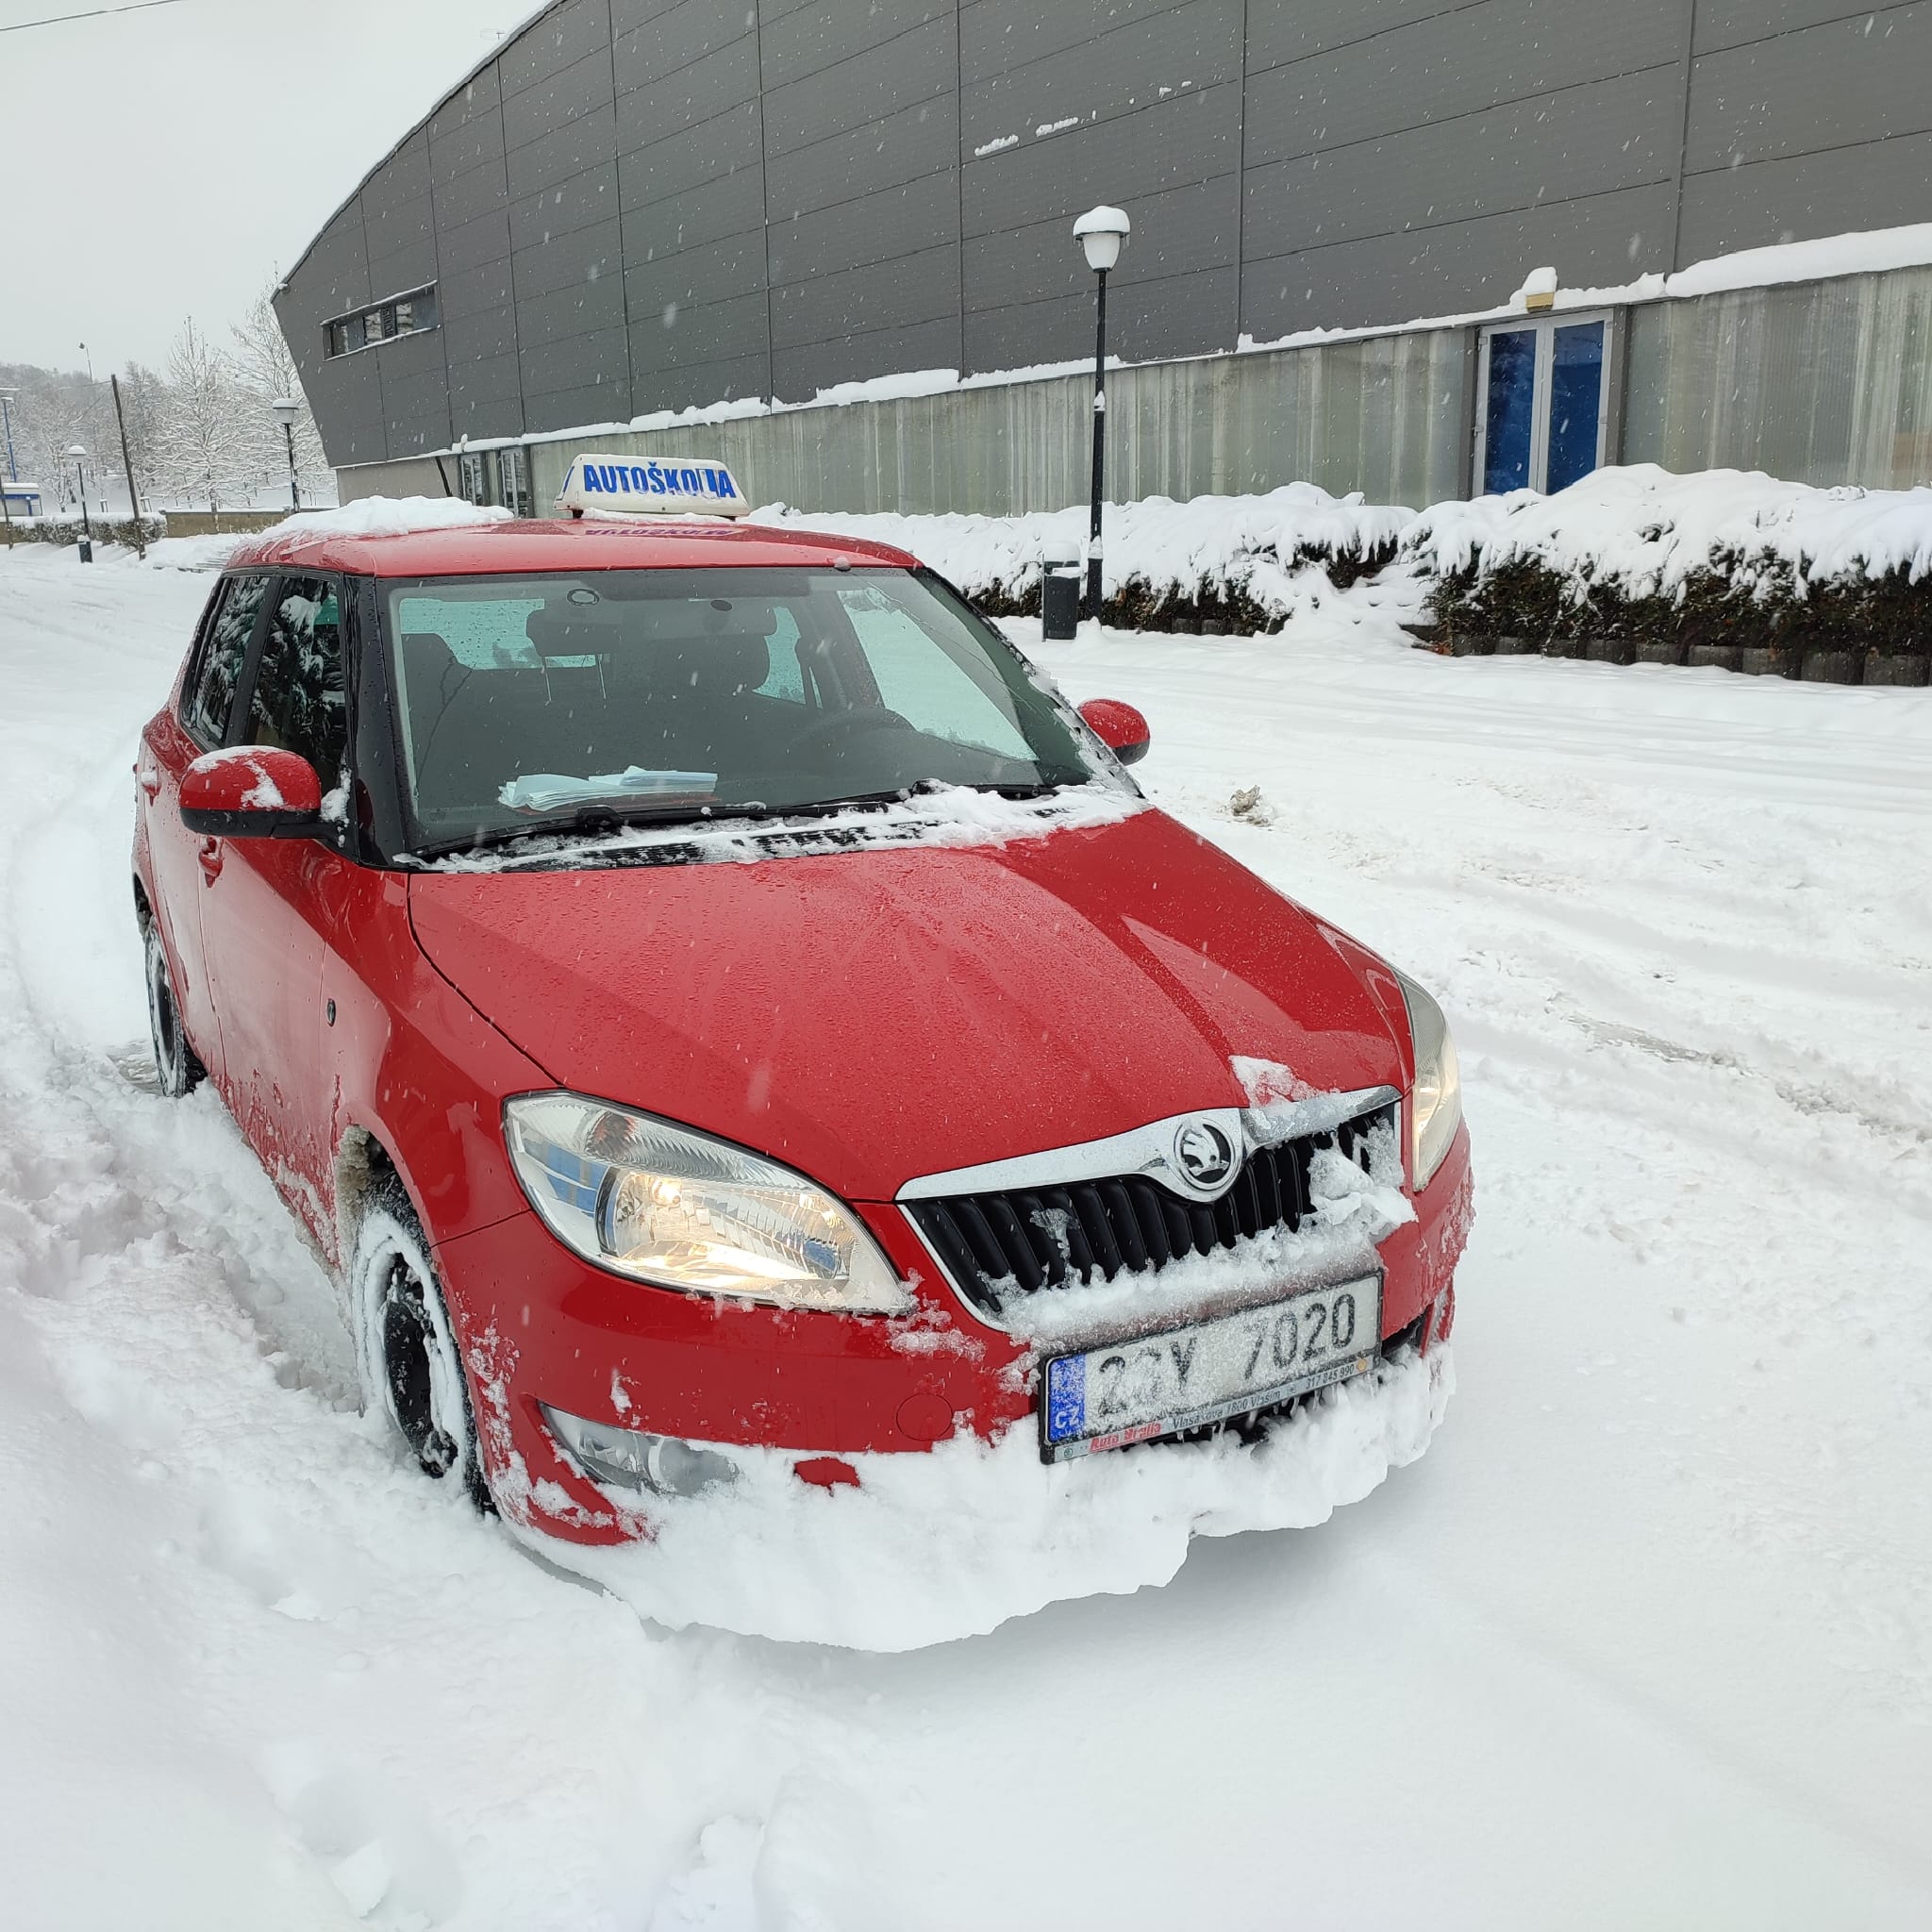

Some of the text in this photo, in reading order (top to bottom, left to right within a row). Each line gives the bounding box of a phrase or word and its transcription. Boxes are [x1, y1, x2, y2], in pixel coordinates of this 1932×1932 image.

[583, 461, 737, 499] AUTOŠKOLA
[1244, 1293, 1356, 1380] 7020
[1055, 1404, 1080, 1429] CZ
